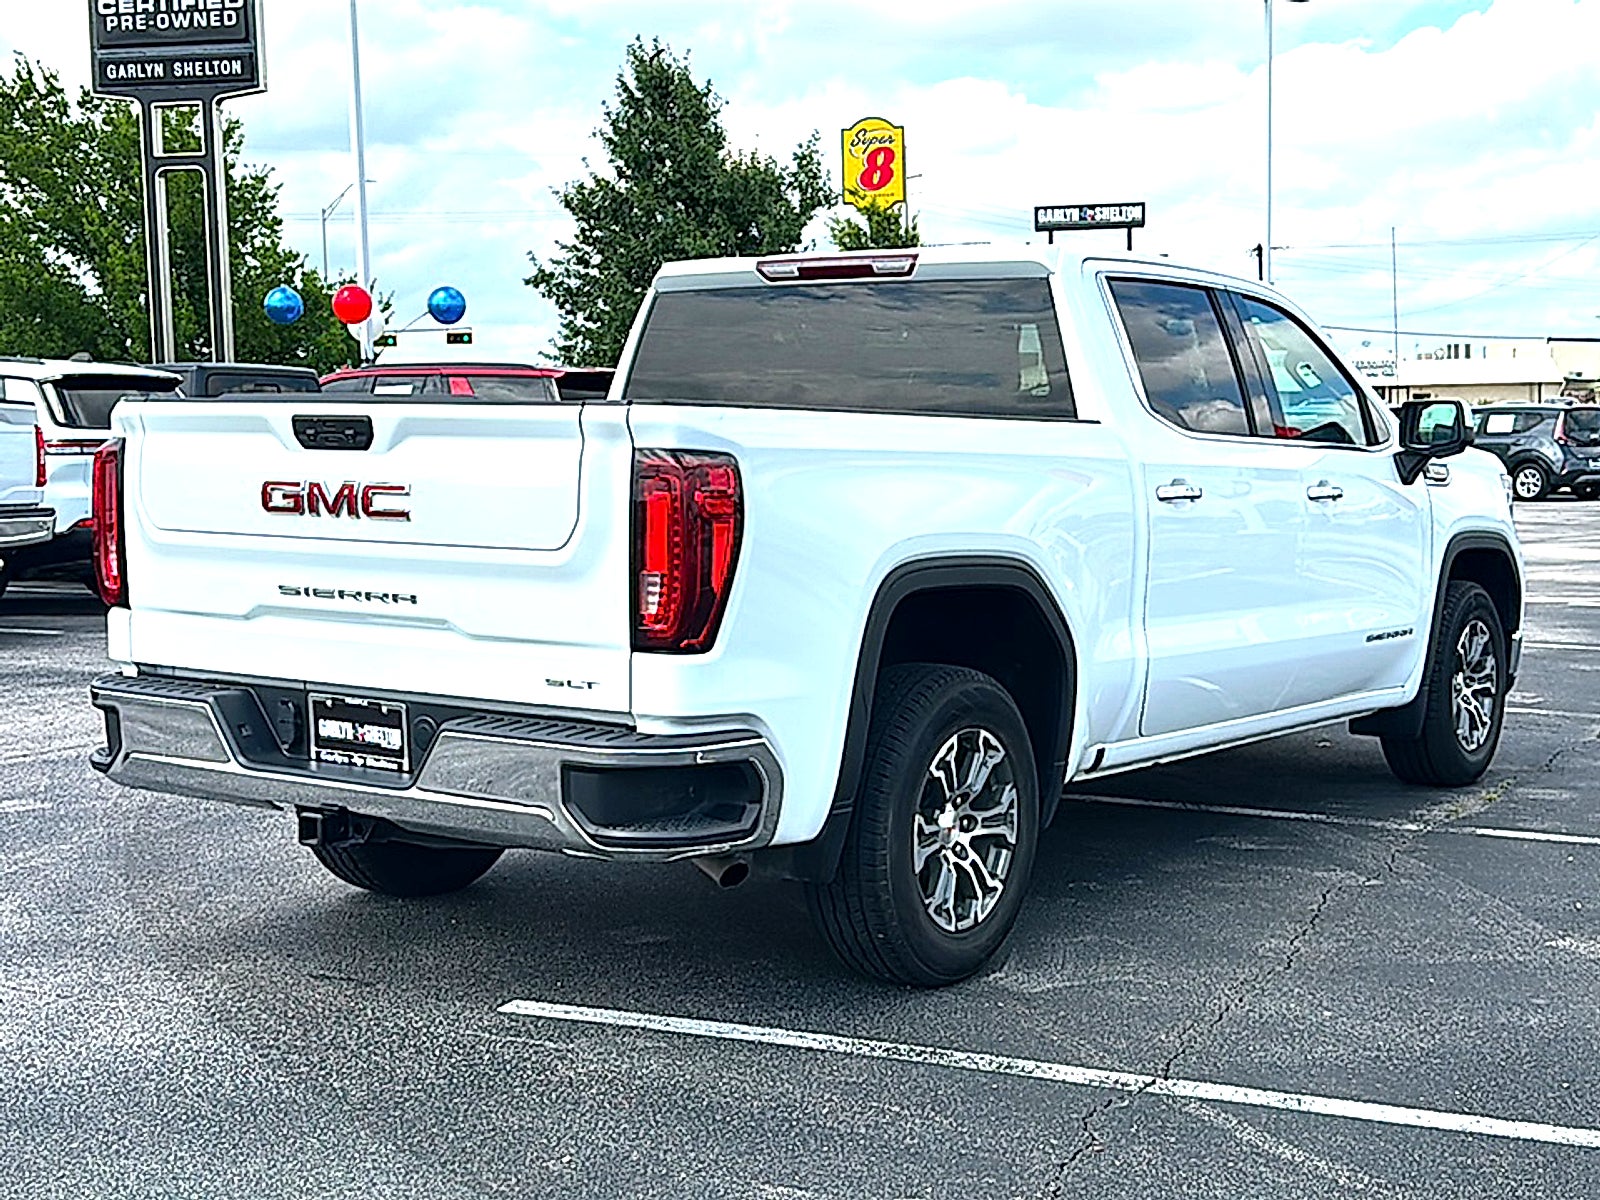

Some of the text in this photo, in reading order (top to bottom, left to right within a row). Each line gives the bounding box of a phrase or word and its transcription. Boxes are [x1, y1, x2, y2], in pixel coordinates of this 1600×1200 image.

[106, 10, 237, 32] PRE-OWNED
[106, 60, 242, 80] GARLYN SHELTON
[850, 128, 895, 155] Super
[859, 146, 895, 191] 8
[261, 479, 412, 522] GMC
[277, 584, 418, 605] SIERRA
[545, 678, 600, 690] SLT
